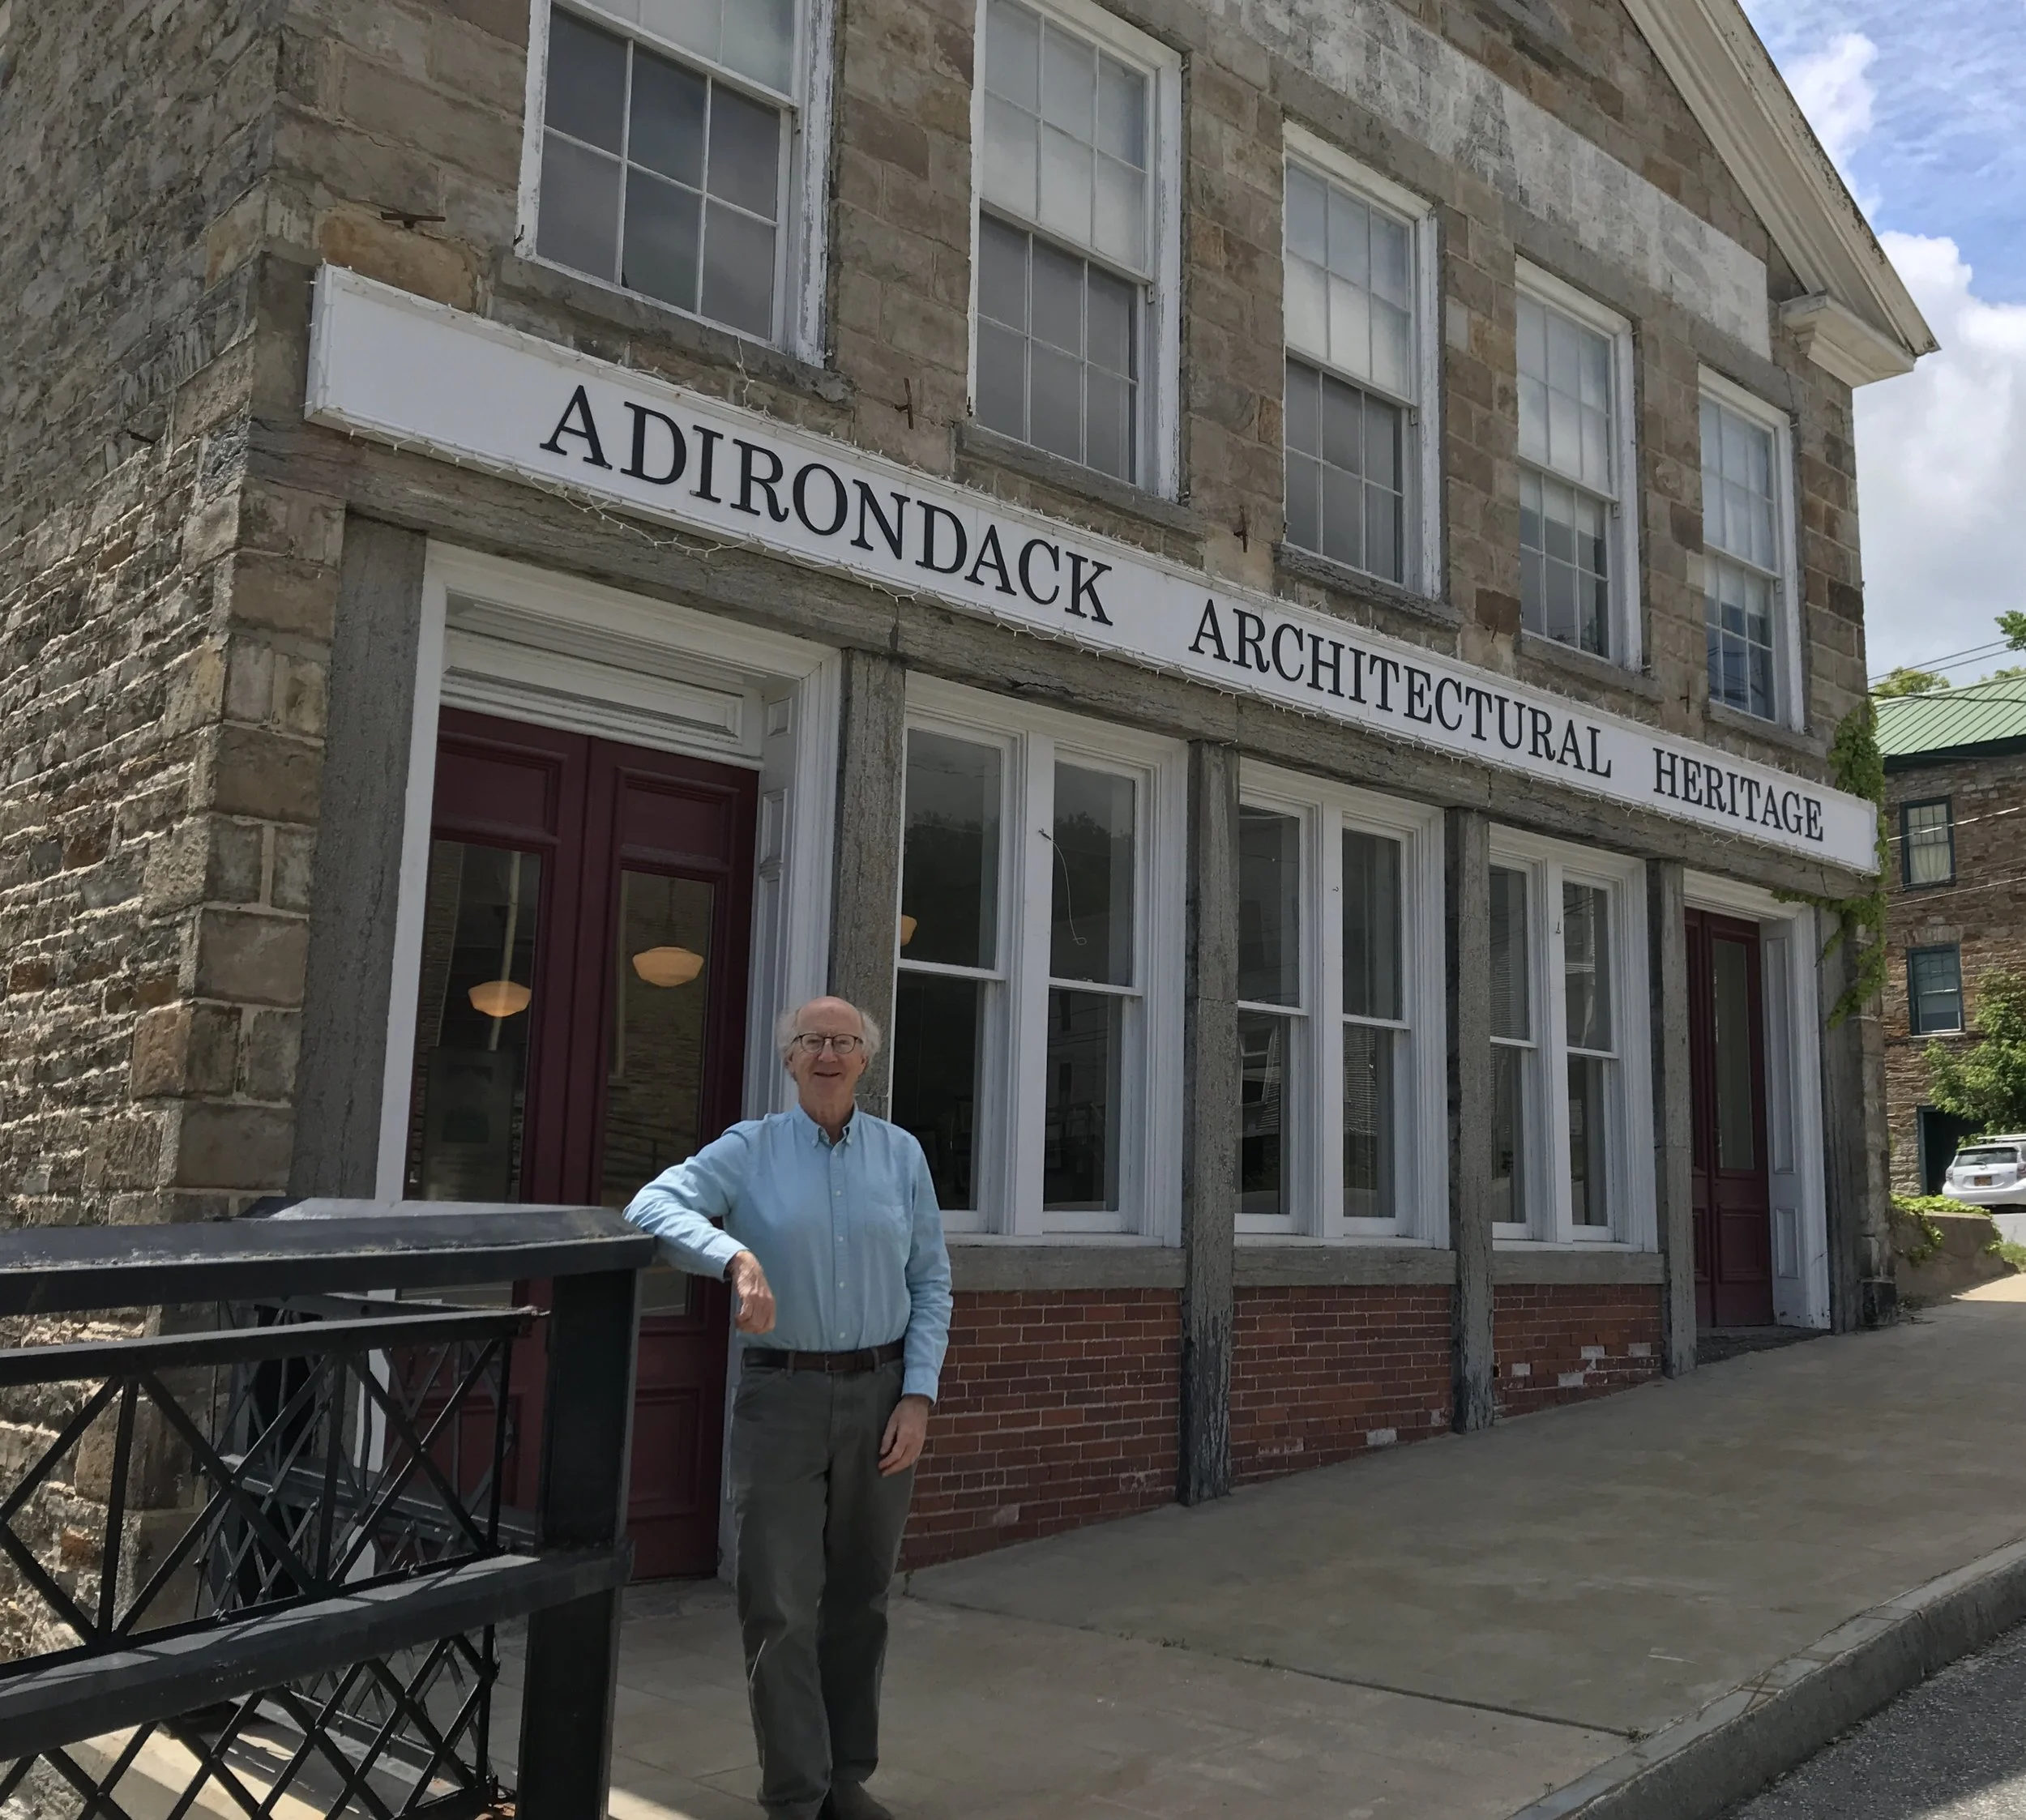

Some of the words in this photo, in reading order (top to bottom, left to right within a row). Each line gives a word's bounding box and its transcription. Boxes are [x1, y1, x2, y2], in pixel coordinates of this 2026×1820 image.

[539, 384, 1113, 627] ADIRONDACK
[1188, 598, 1612, 779] ARCHITECTURAL
[1652, 747, 1823, 843] HERITAGE
